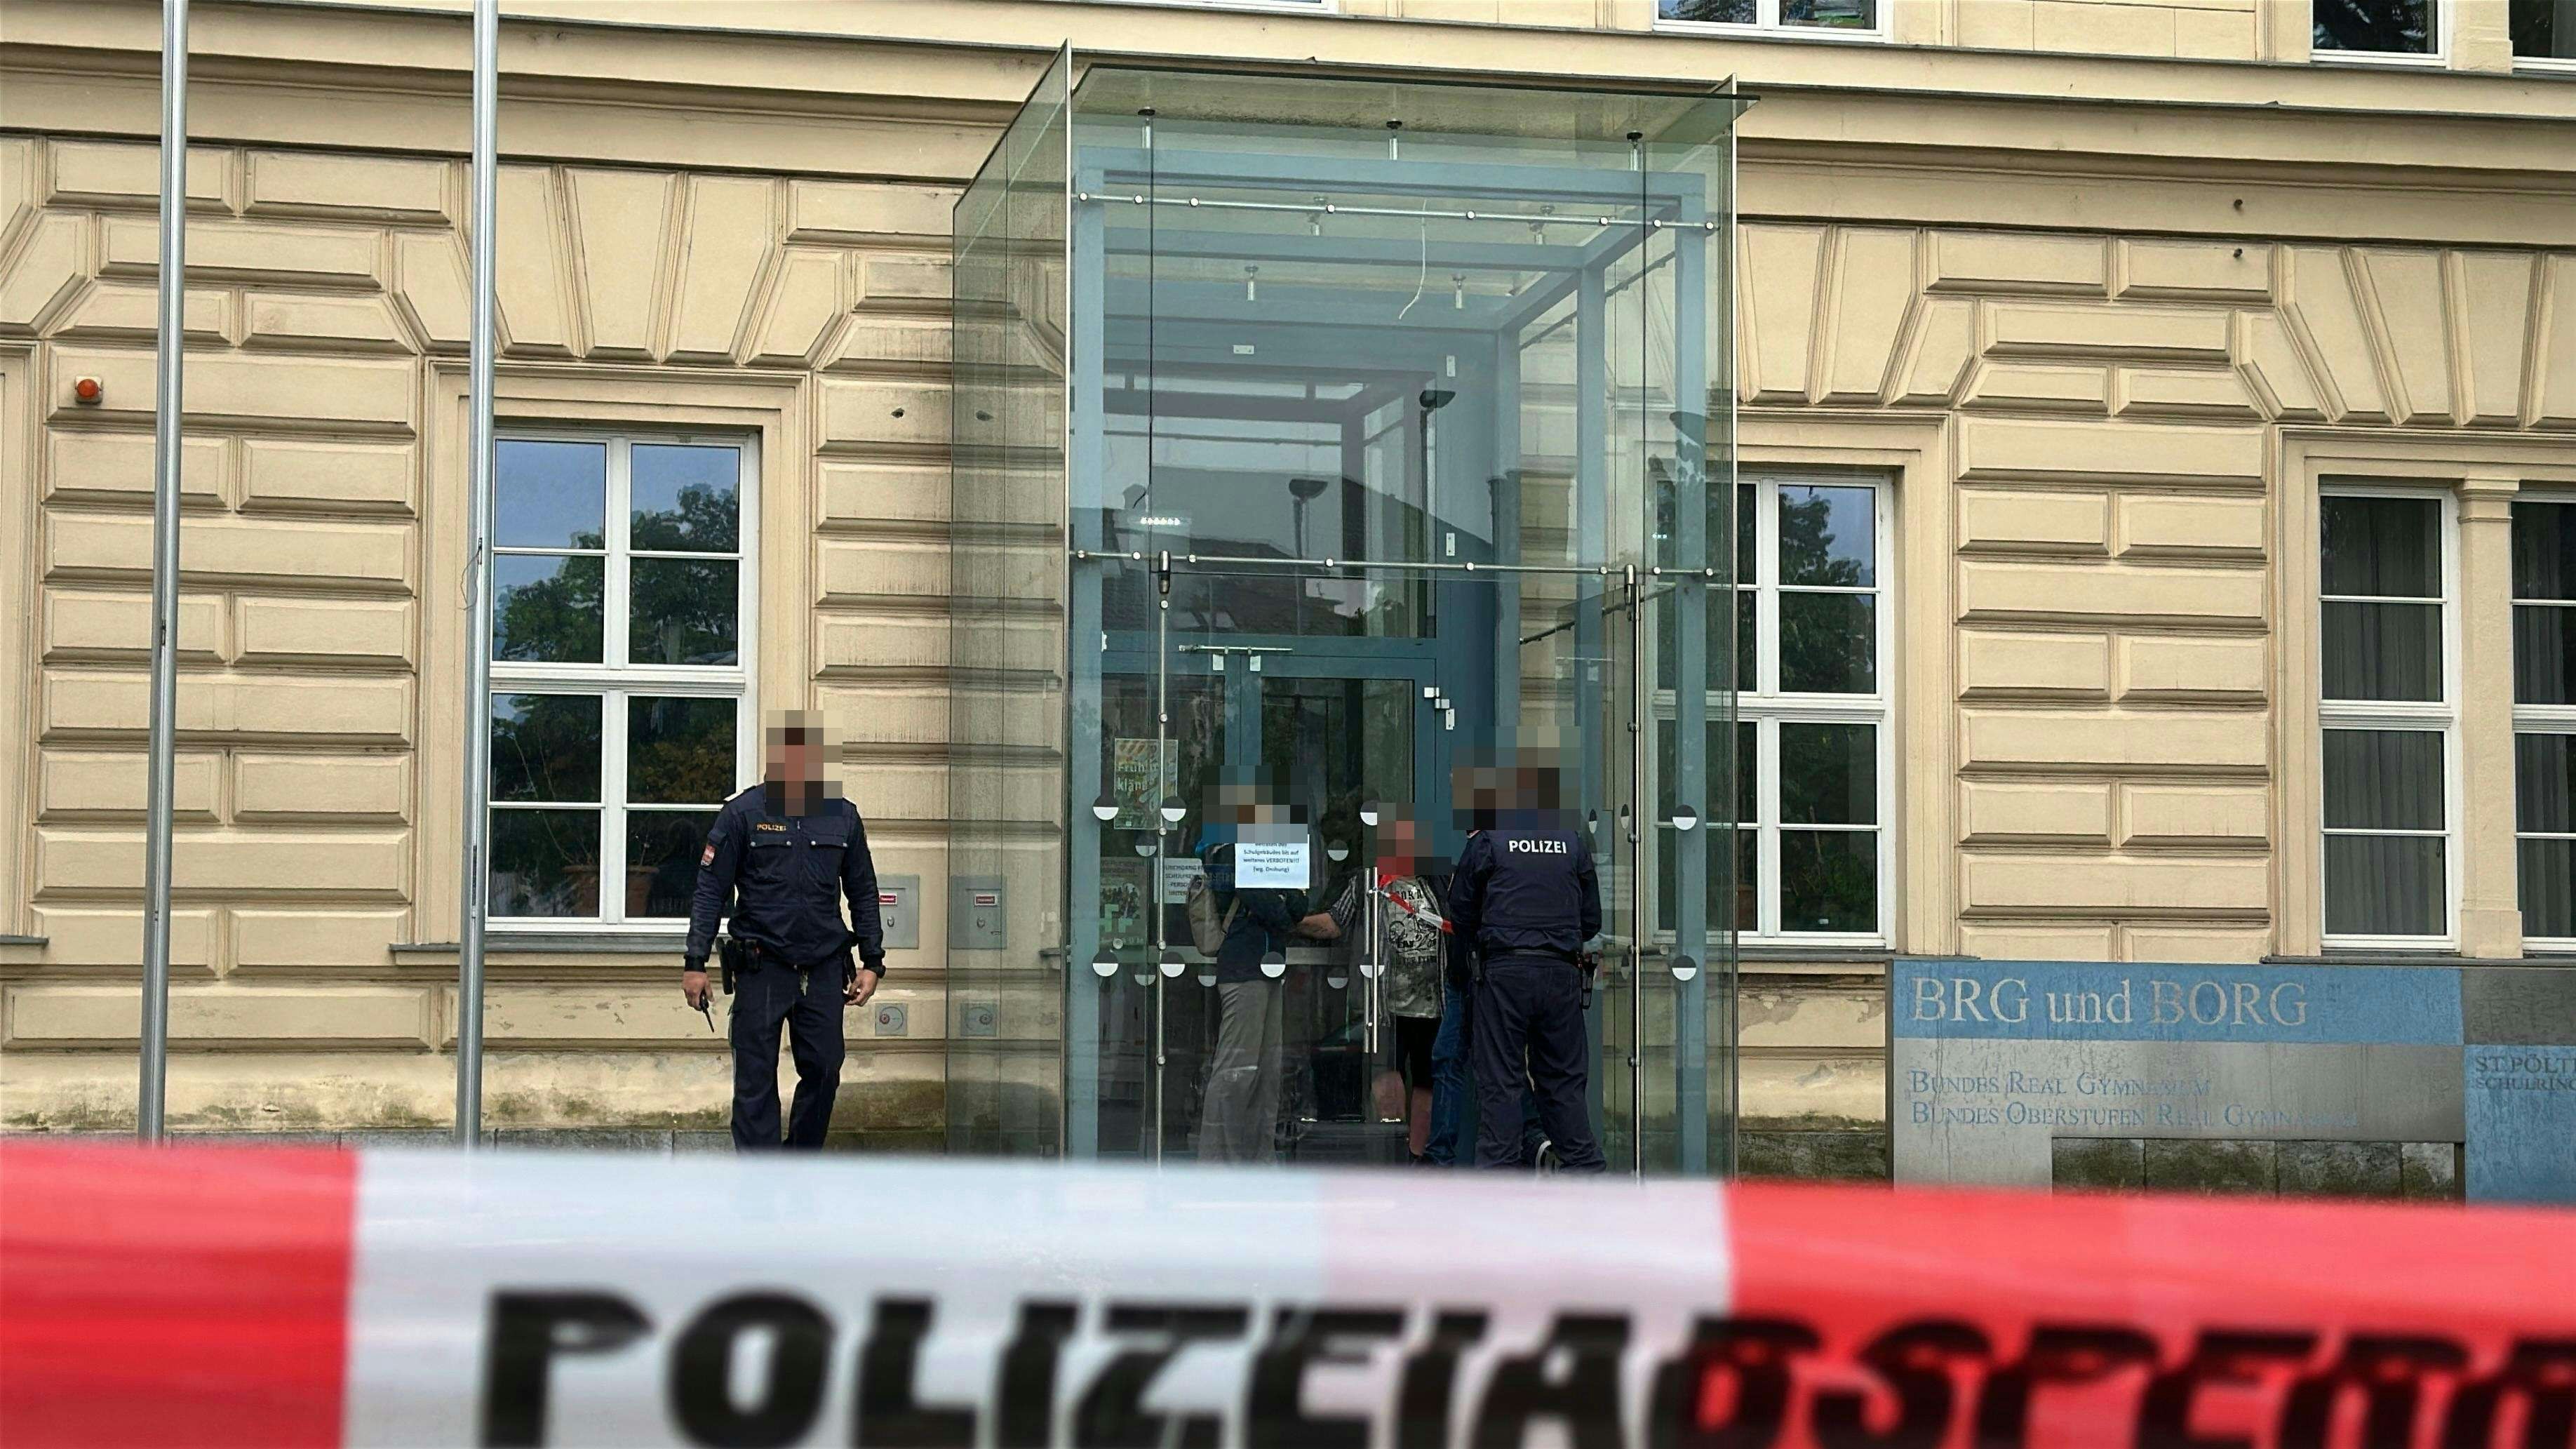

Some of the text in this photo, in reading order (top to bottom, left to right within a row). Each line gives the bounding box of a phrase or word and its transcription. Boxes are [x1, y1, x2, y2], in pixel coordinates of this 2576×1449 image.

[1508, 840, 1567, 854] POLIZEI
[1910, 977, 2307, 1027] BRG und BORG
[2156, 1103, 2210, 1127] REL
